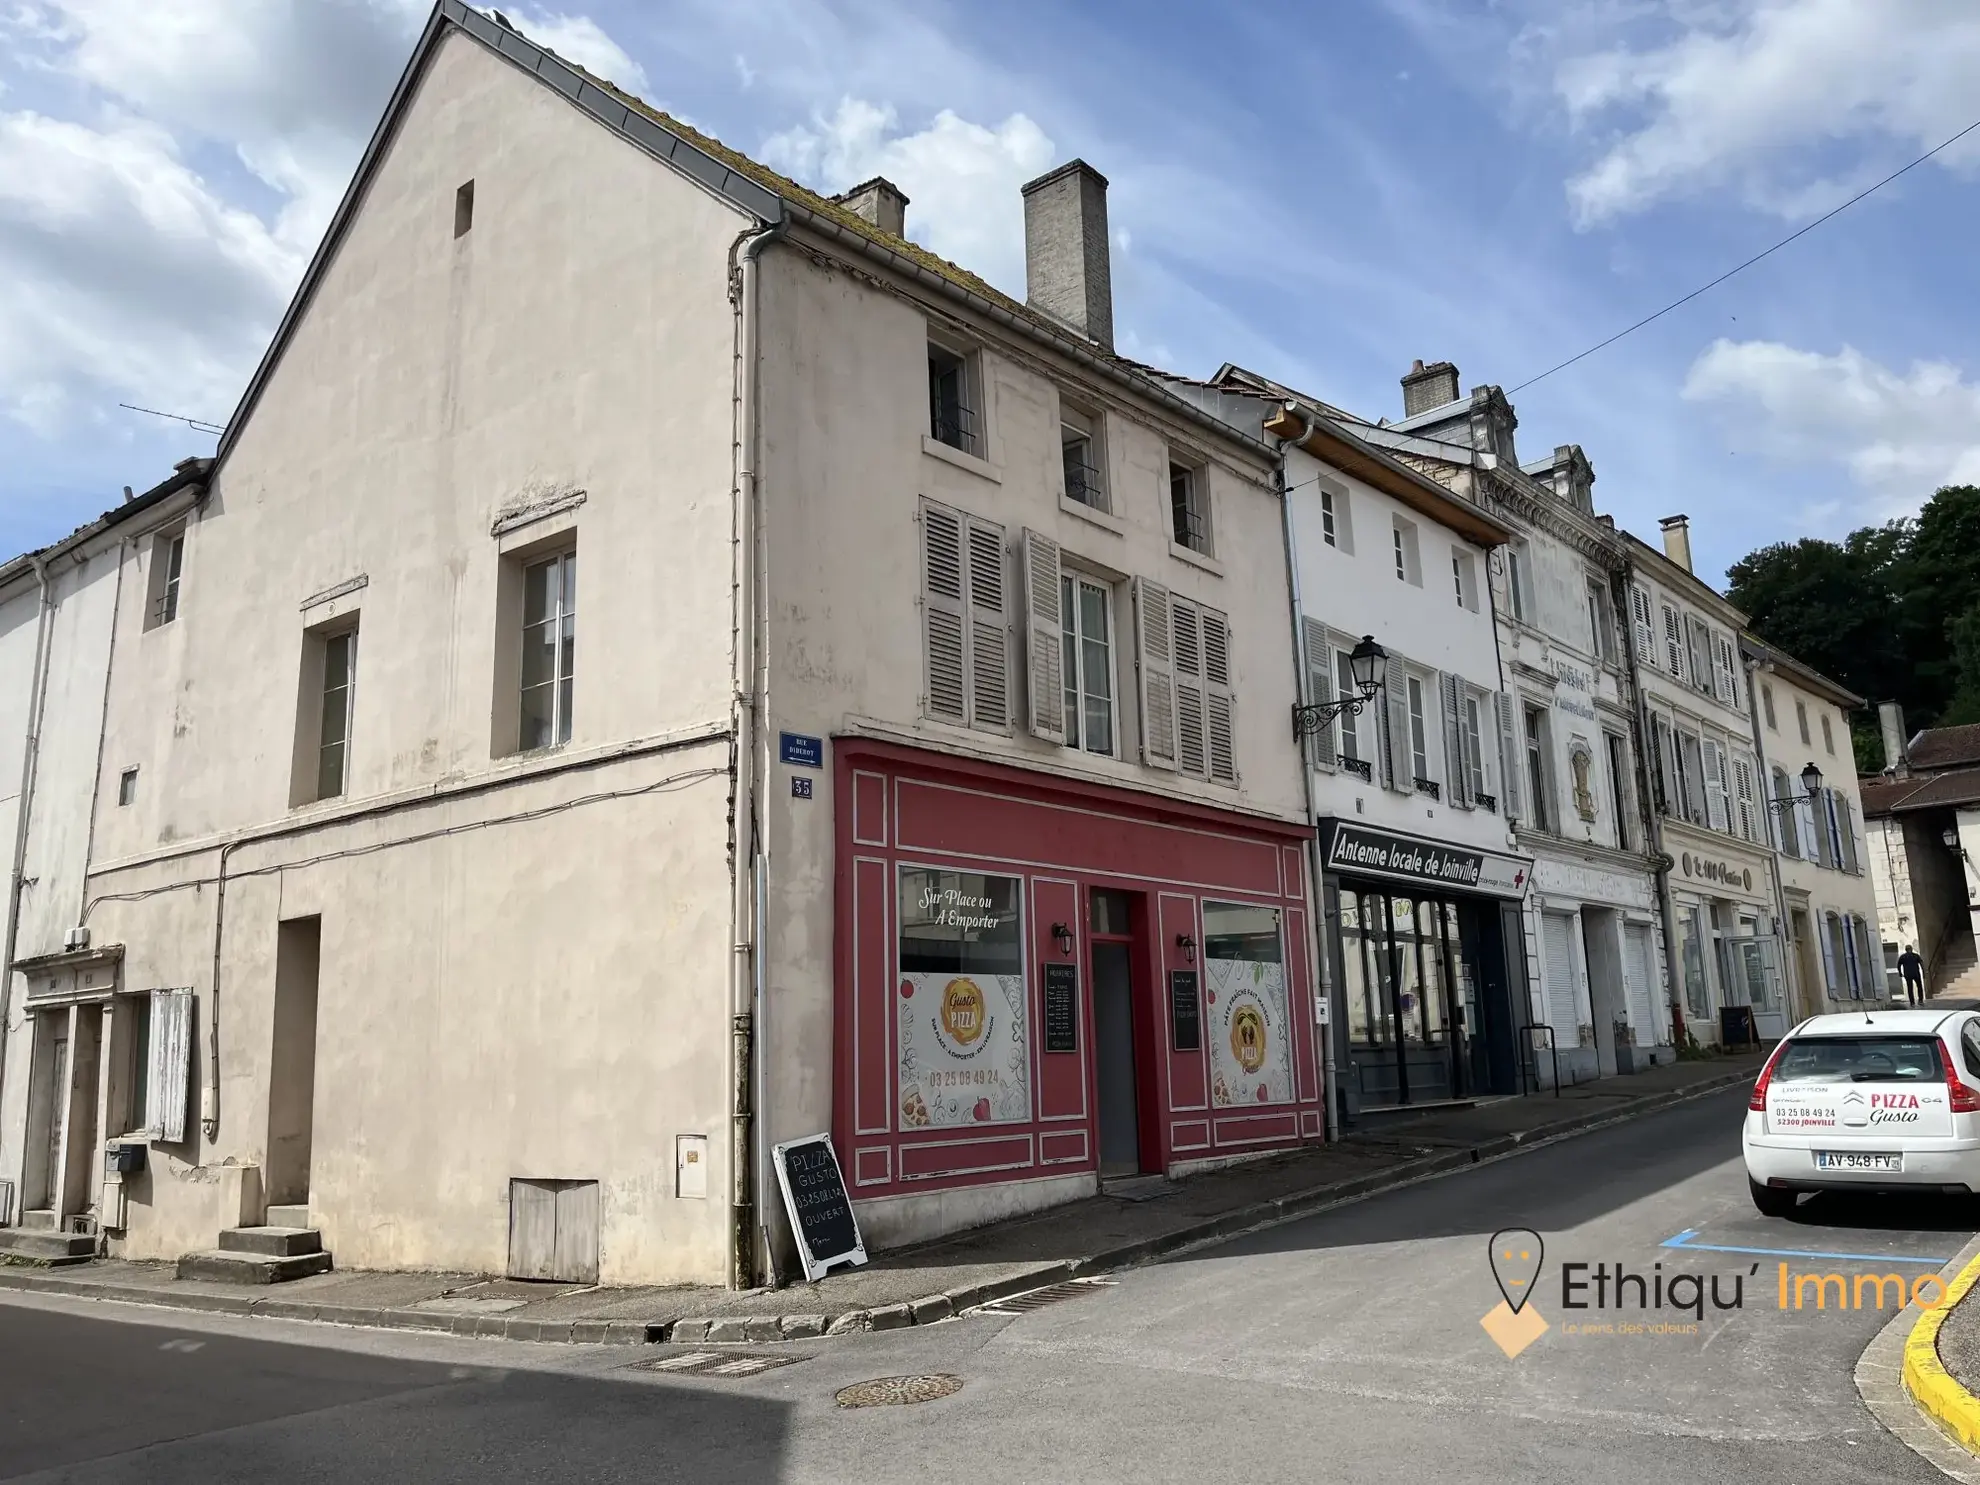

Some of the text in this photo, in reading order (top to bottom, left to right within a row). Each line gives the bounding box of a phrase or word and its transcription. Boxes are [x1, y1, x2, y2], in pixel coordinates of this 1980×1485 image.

[789, 746, 815, 757] DIDEROT
[795, 780, 810, 795] 35
[1335, 833, 1478, 882] Antenne locale de Joinville
[918, 887, 992, 909] Sur Place ou
[935, 909, 999, 933] A Emporter
[949, 992, 976, 1010] Gusto
[951, 1011, 977, 1029] PIZZA
[930, 1069, 999, 1087] 03 25 08 49 24
[1871, 1093, 1920, 1109] PIZZA
[1776, 1108, 1836, 1117] 03 25 08 49 24
[1869, 1109, 1920, 1126] Gusto
[1777, 1118, 1835, 1127] 52300 JOINVILLE
[792, 1149, 831, 1172] PIZZA
[798, 1167, 837, 1187] GUSTO
[805, 1206, 844, 1226] OUVERT
